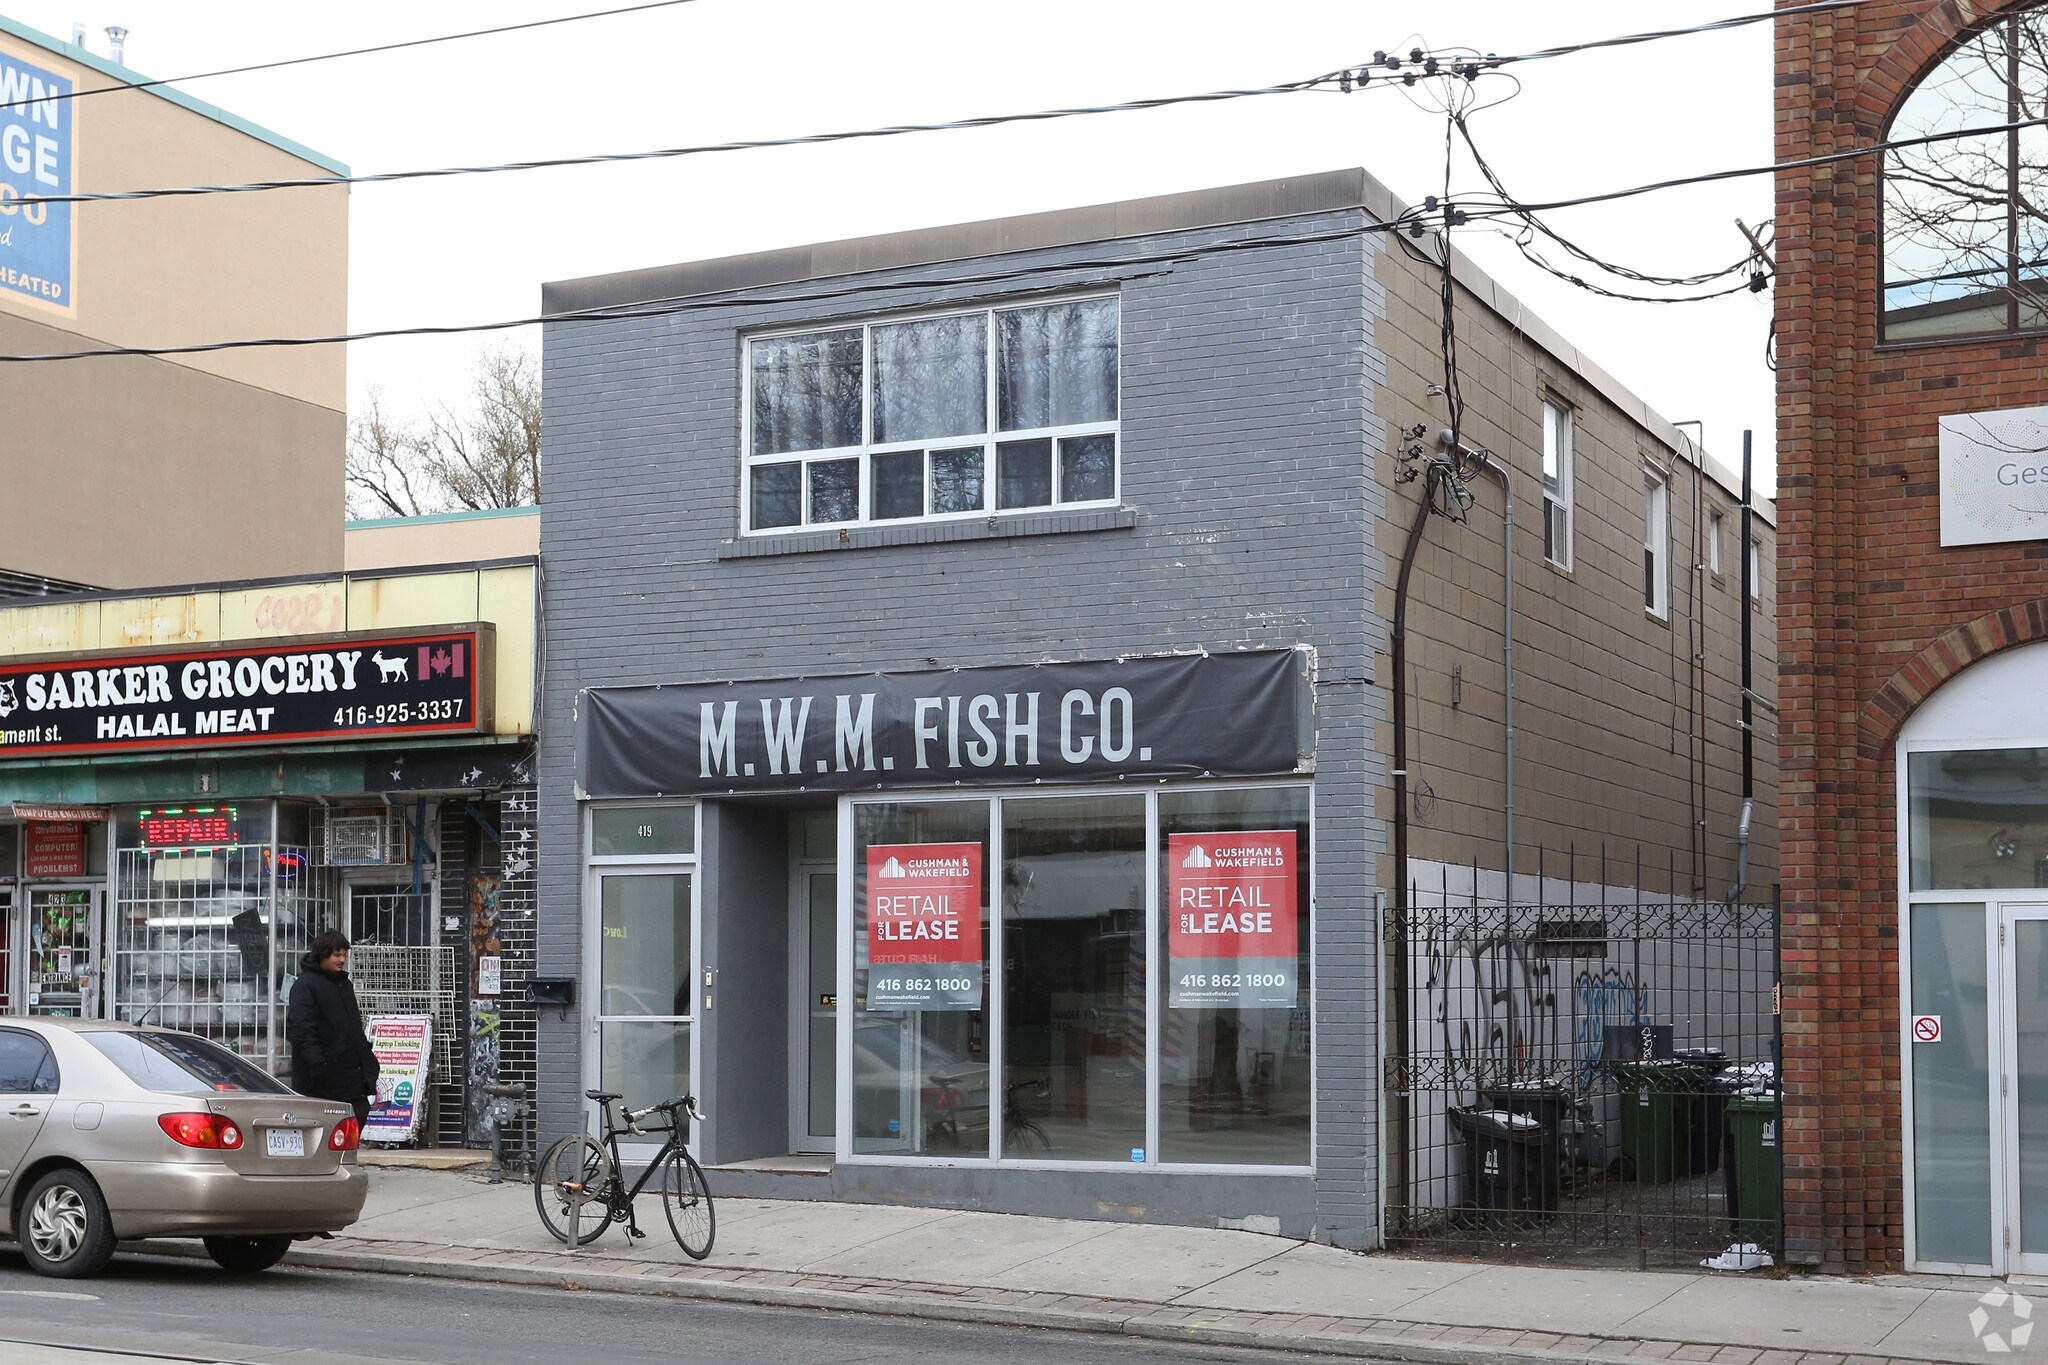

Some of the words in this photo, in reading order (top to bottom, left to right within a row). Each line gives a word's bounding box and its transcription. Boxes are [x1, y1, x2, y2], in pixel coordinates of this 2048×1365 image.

[26, 665, 172, 711] SARKER
[181, 651, 362, 700] GROCERY
[334, 699, 463, 726] 416-925-3337
[97, 712, 186, 739] HALAL
[195, 708, 275, 734] MEAT
[699, 692, 895, 778] M.W.M.
[914, 691, 1041, 769] FISH
[1060, 686, 1153, 765] CO.
[45, 724, 62, 742] st.
[148, 818, 230, 843] REPAIR
[637, 825, 652, 838] 419
[1214, 848, 1272, 858] CUSHMAN
[1275, 847, 1283, 856] &
[33, 863, 78, 874] PROBLEMS?
[908, 859, 959, 868] CUSHMAN
[962, 858, 969, 867] &
[1215, 857, 1284, 867] WAKEFIELD
[909, 868, 970, 878] WAKEFIELD
[877, 895, 957, 916] RETAIL
[1180, 886, 1271, 908] RETAIL
[885, 920, 959, 941] LEASE
[1189, 912, 1273, 934] LEASE
[876, 979, 901, 991] 416
[905, 979, 932, 991] 862
[935, 978, 971, 991] 1800
[1179, 974, 1206, 987] 416
[1211, 974, 1241, 987] 862
[1246, 974, 1285, 987] 1800
[376, 1040, 393, 1049] Laptop
